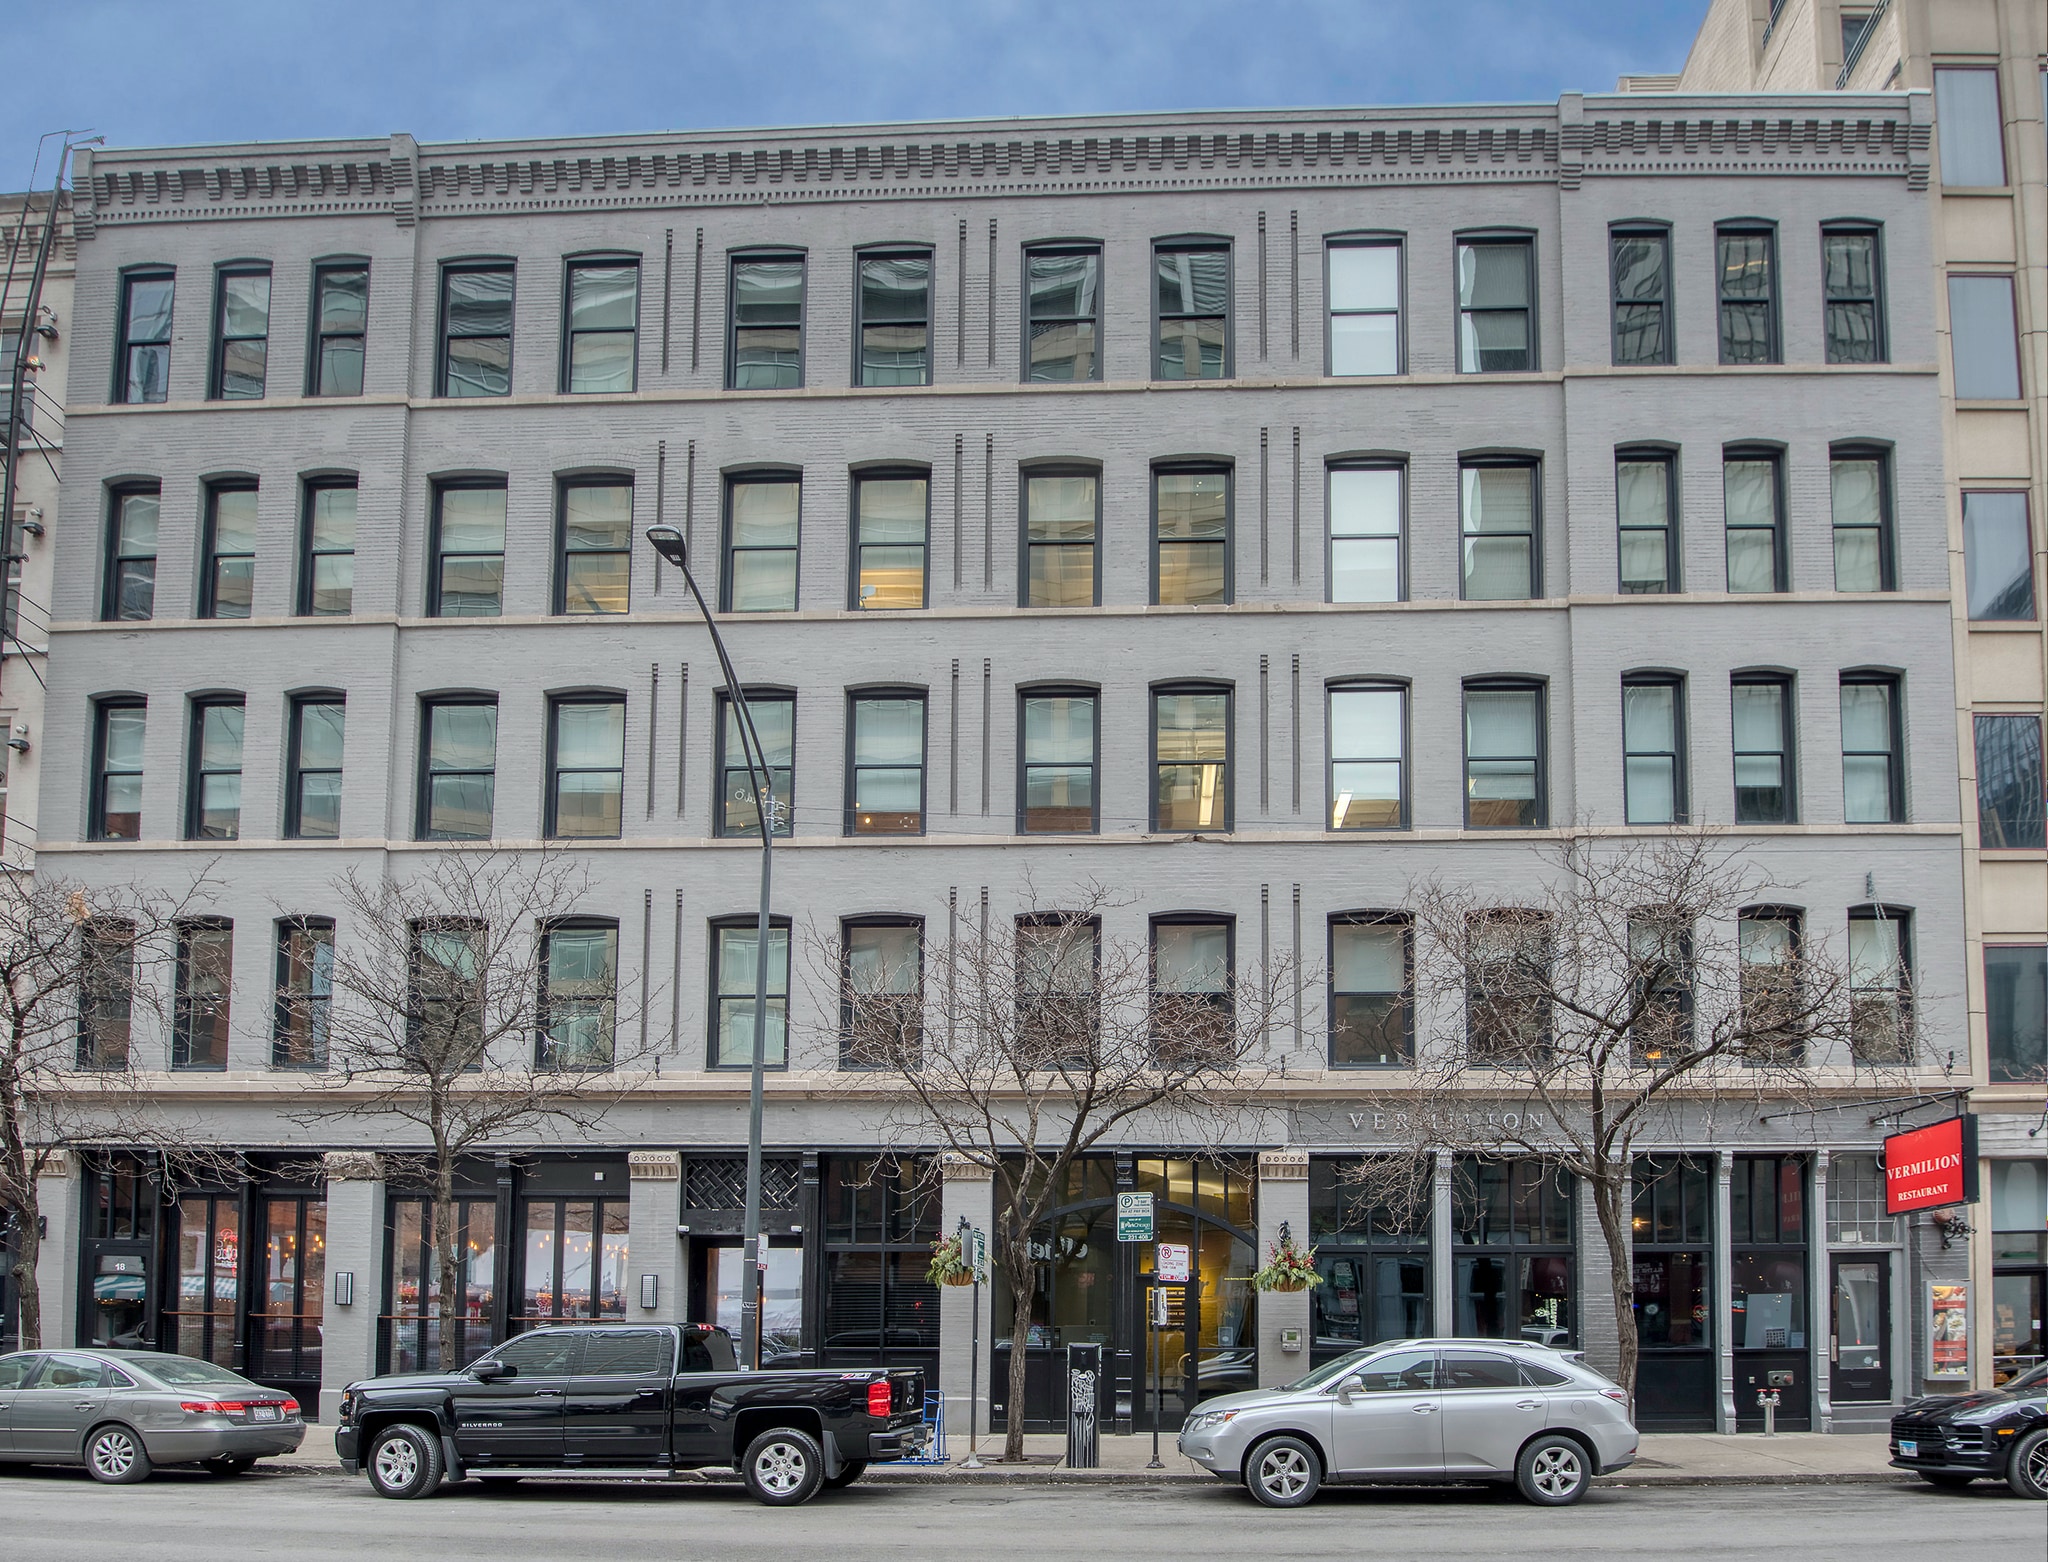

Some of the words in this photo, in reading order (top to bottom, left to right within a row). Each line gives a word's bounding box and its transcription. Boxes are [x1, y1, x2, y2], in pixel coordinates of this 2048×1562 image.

[1887, 1153, 1961, 1180] VERMILION
[1897, 1183, 1949, 1202] RESTAURANT
[115, 1262, 126, 1271] 18
